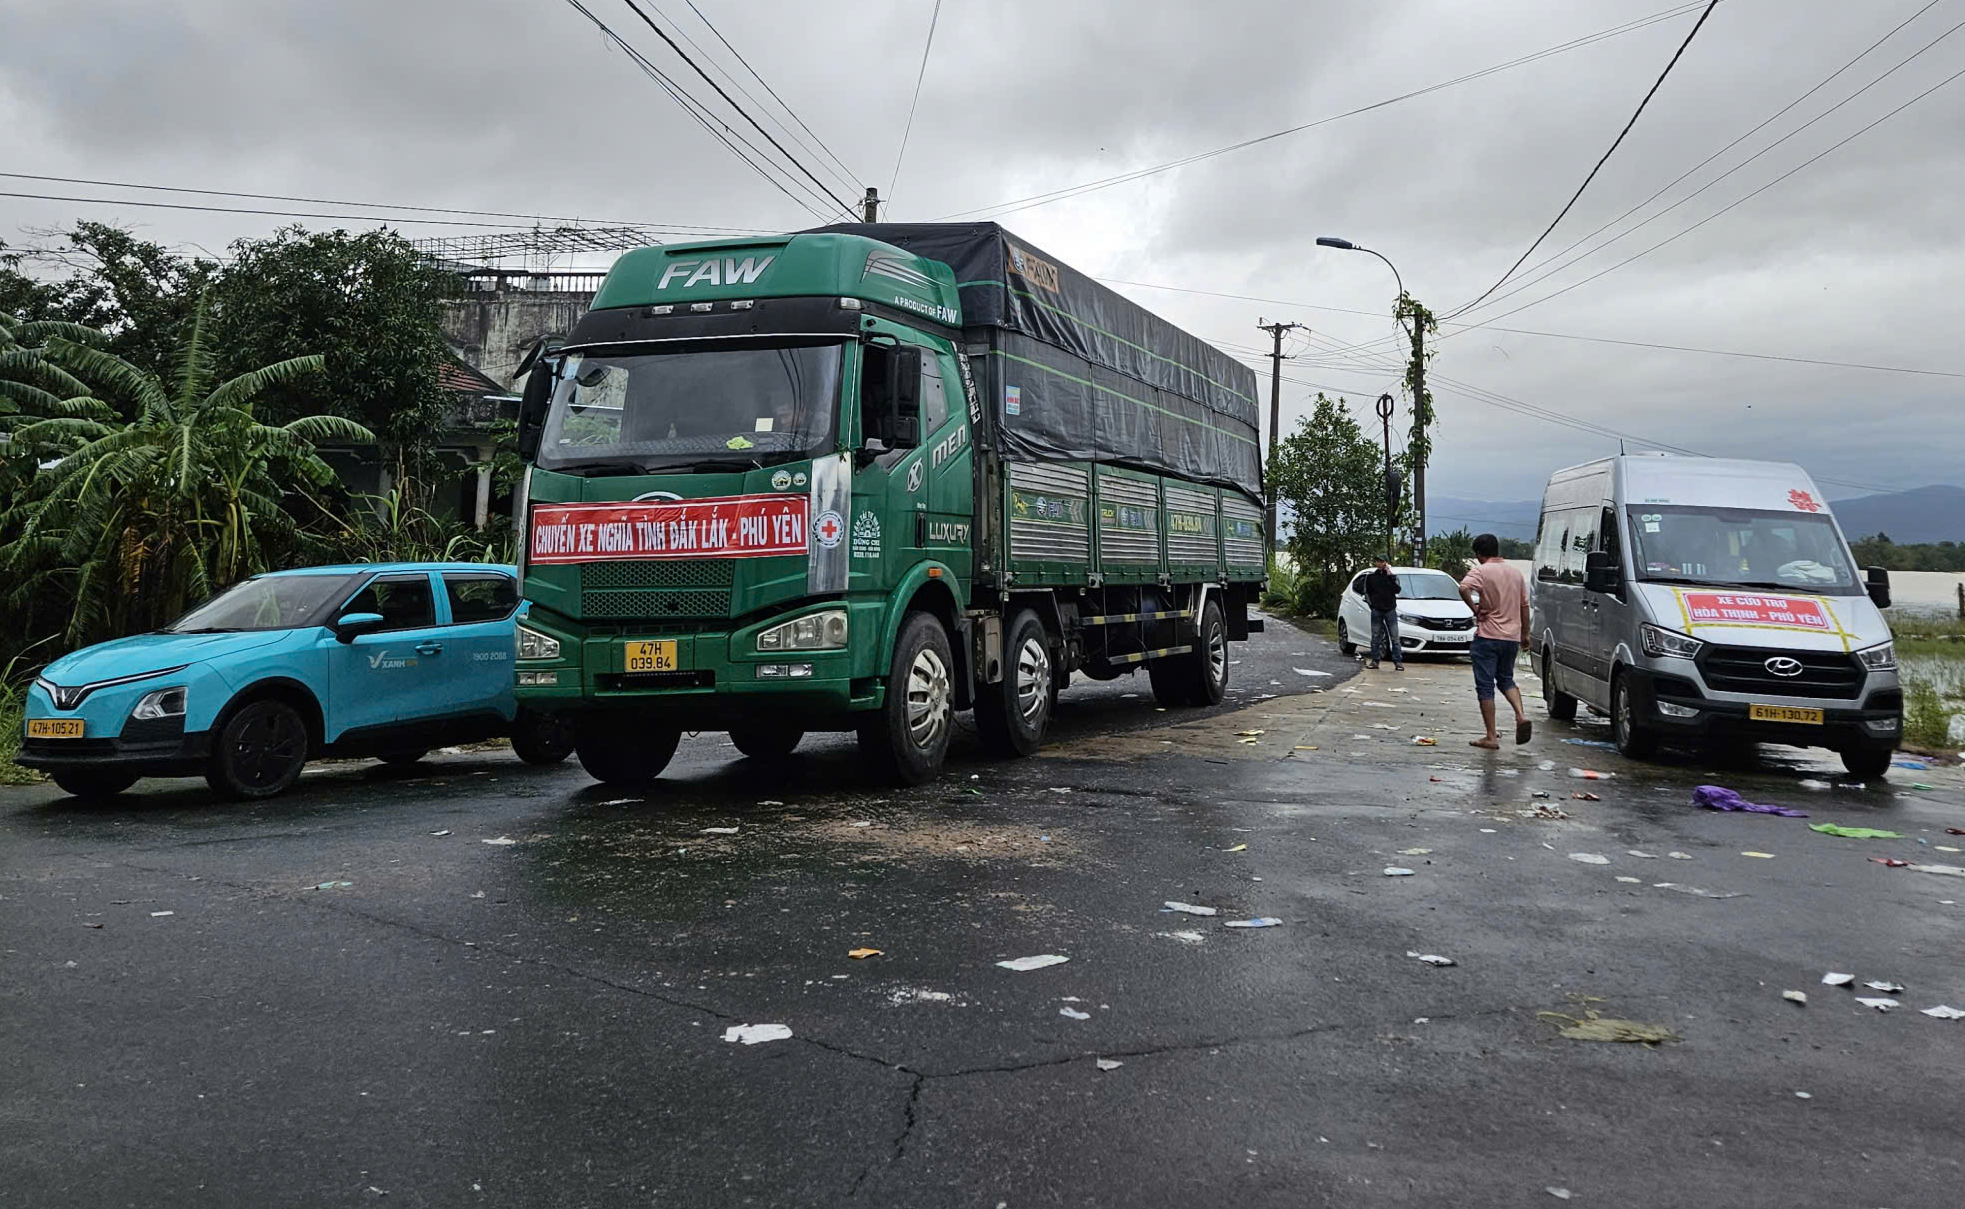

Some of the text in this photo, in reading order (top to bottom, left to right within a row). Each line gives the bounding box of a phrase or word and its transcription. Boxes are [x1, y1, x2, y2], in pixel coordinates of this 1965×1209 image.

[657, 255, 776, 290] FAW
[894, 295, 958, 324] A PRODUCT OF FAW
[535, 513, 576, 554] CHUYẾN
[578, 523, 595, 553] XE
[597, 515, 634, 553] NGHĨA
[636, 514, 666, 551] TÌNH
[669, 507, 698, 550] ĐẮK
[701, 505, 728, 549] LẮK
[740, 507, 767, 546] PHÚ
[772, 506, 802, 544] YÊN
[929, 522, 969, 544] LUXURY
[1717, 596, 1735, 605] XE
[1693, 606, 1719, 617] HÒA
[1720, 608, 1760, 620] THỊNH
[1767, 610, 1796, 623] PHÚ
[1795, 613, 1825, 625] YÊN
[640, 643, 662, 655] 47H
[382, 660, 406, 669] XANH
[631, 656, 671, 670] 039.84
[1756, 708, 1817, 722] 61H-130.72
[32, 722, 79, 735] 47H-105.21
